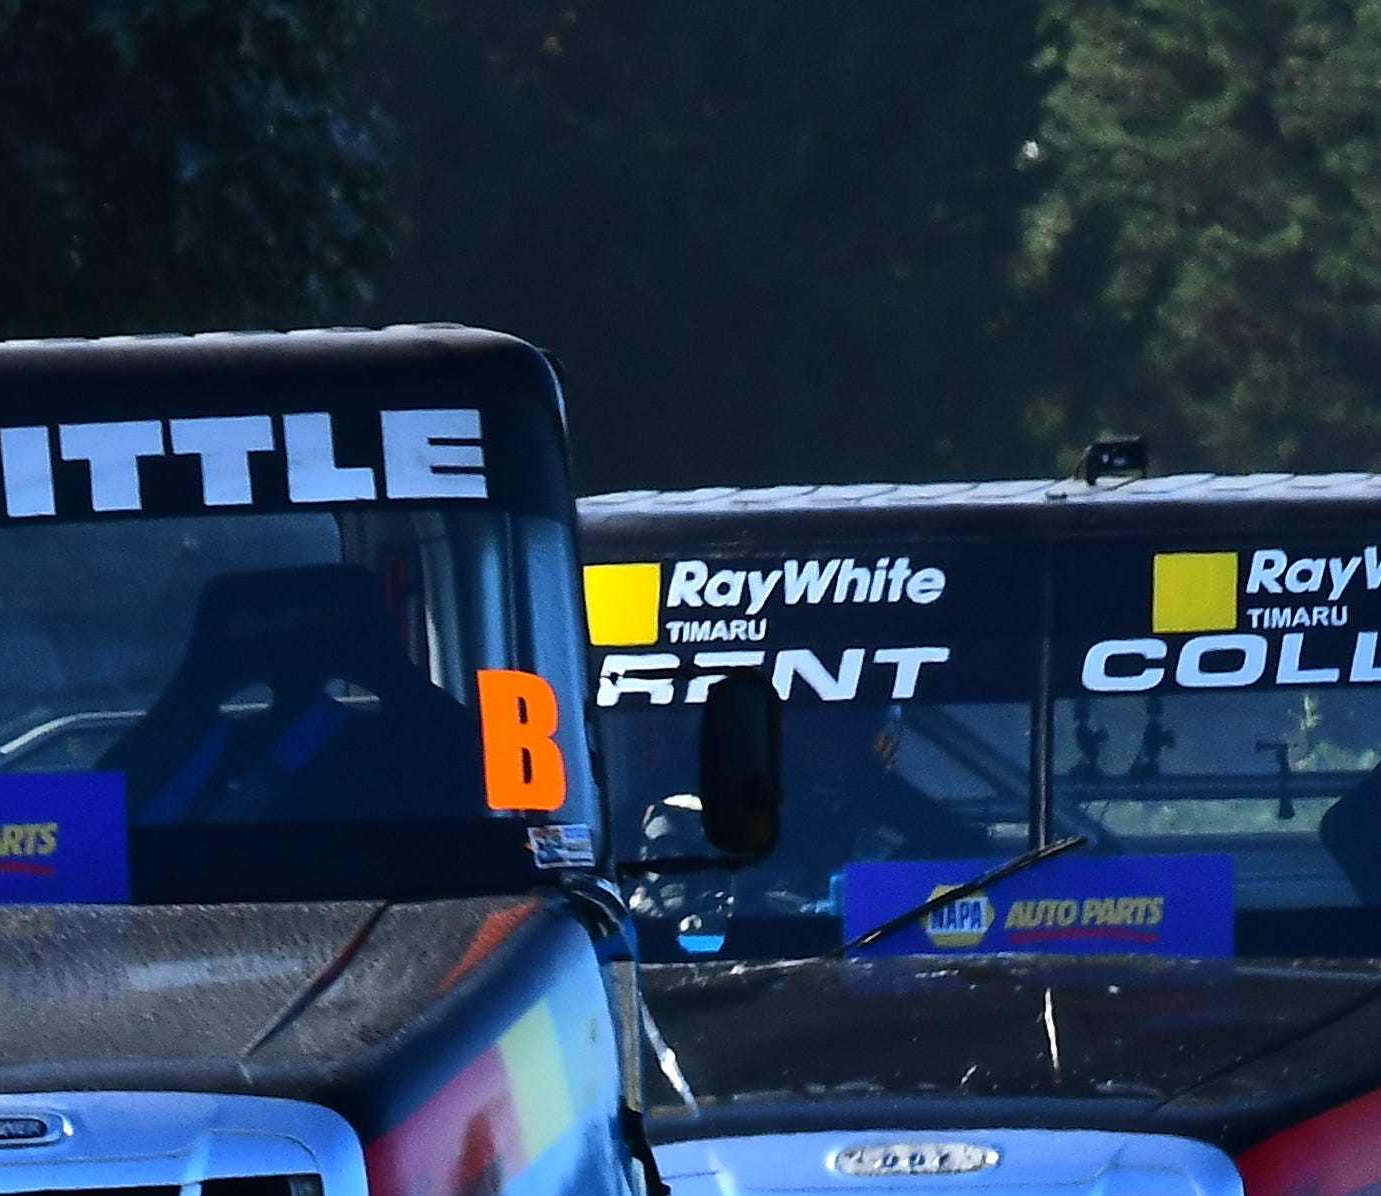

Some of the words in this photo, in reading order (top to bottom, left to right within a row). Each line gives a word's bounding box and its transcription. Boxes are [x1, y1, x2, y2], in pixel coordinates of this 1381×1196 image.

[665, 618, 767, 644] TIMARU
[1246, 605, 1348, 629] TIMARU
[477, 669, 566, 811] B
[930, 899, 984, 932] NAPA
[1005, 899, 1077, 929] AUTO
[1082, 896, 1164, 926] PARTS
